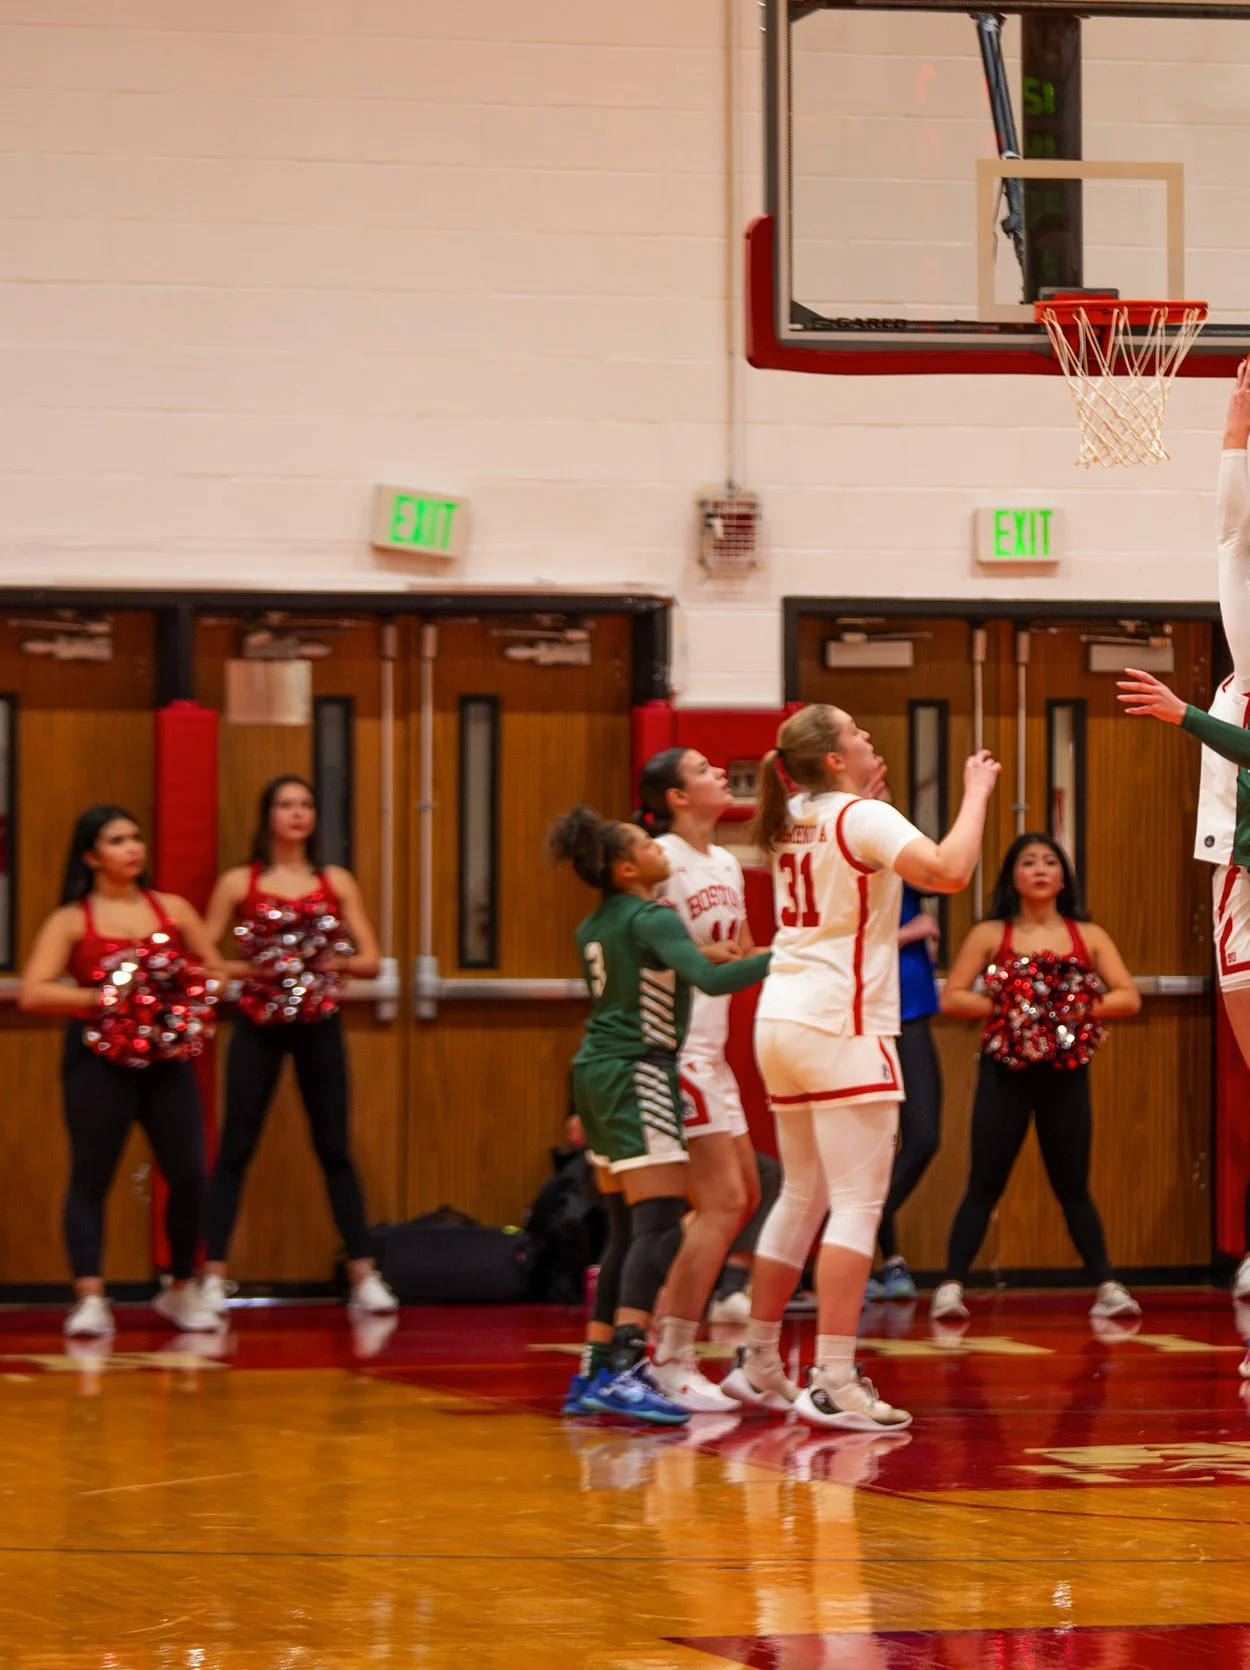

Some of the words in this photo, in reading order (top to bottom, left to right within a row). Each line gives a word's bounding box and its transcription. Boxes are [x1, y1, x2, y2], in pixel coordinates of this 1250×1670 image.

[389, 495, 458, 549] EXIT
[995, 509, 1053, 557] EXIT
[779, 852, 821, 927] 31
[584, 941, 607, 998] 3
